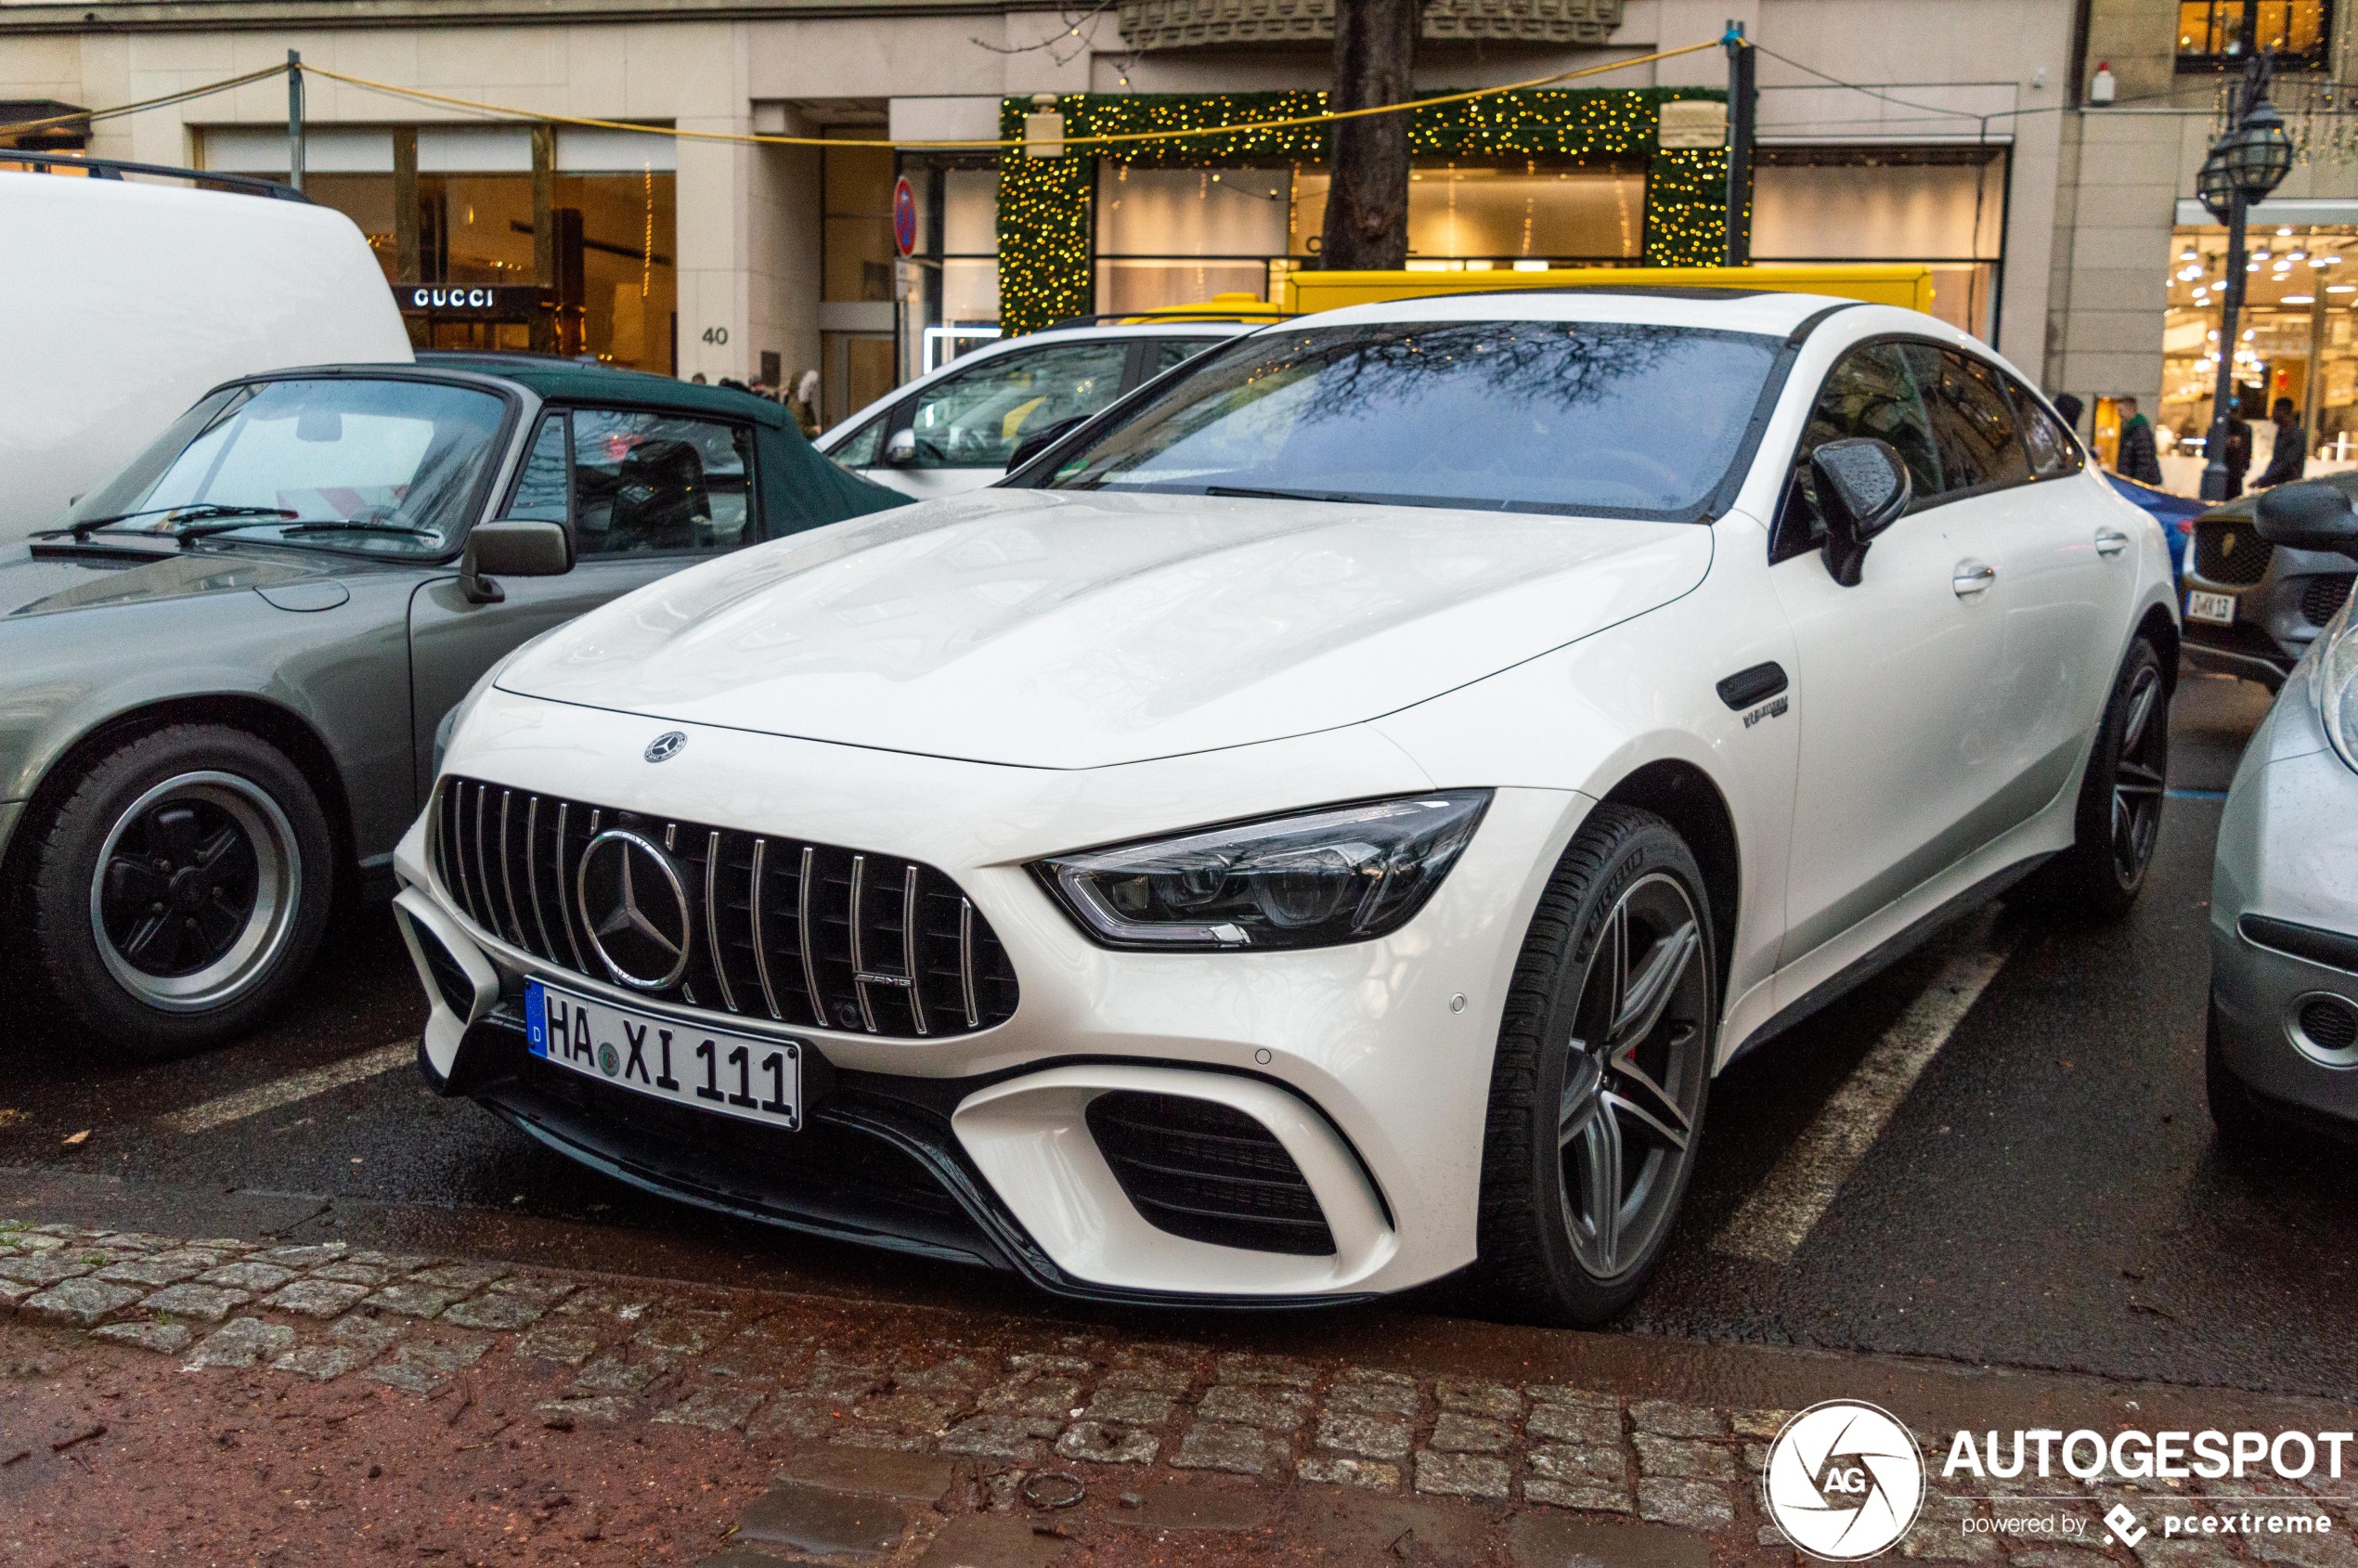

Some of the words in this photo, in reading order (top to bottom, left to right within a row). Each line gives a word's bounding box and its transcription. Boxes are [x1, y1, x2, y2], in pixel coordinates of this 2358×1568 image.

[414, 289, 493, 307] GUCCI
[703, 327, 728, 345] 40
[533, 1026, 541, 1043] D
[546, 995, 595, 1067] HA
[623, 1019, 680, 1092] XI
[696, 1039, 793, 1115] 111
